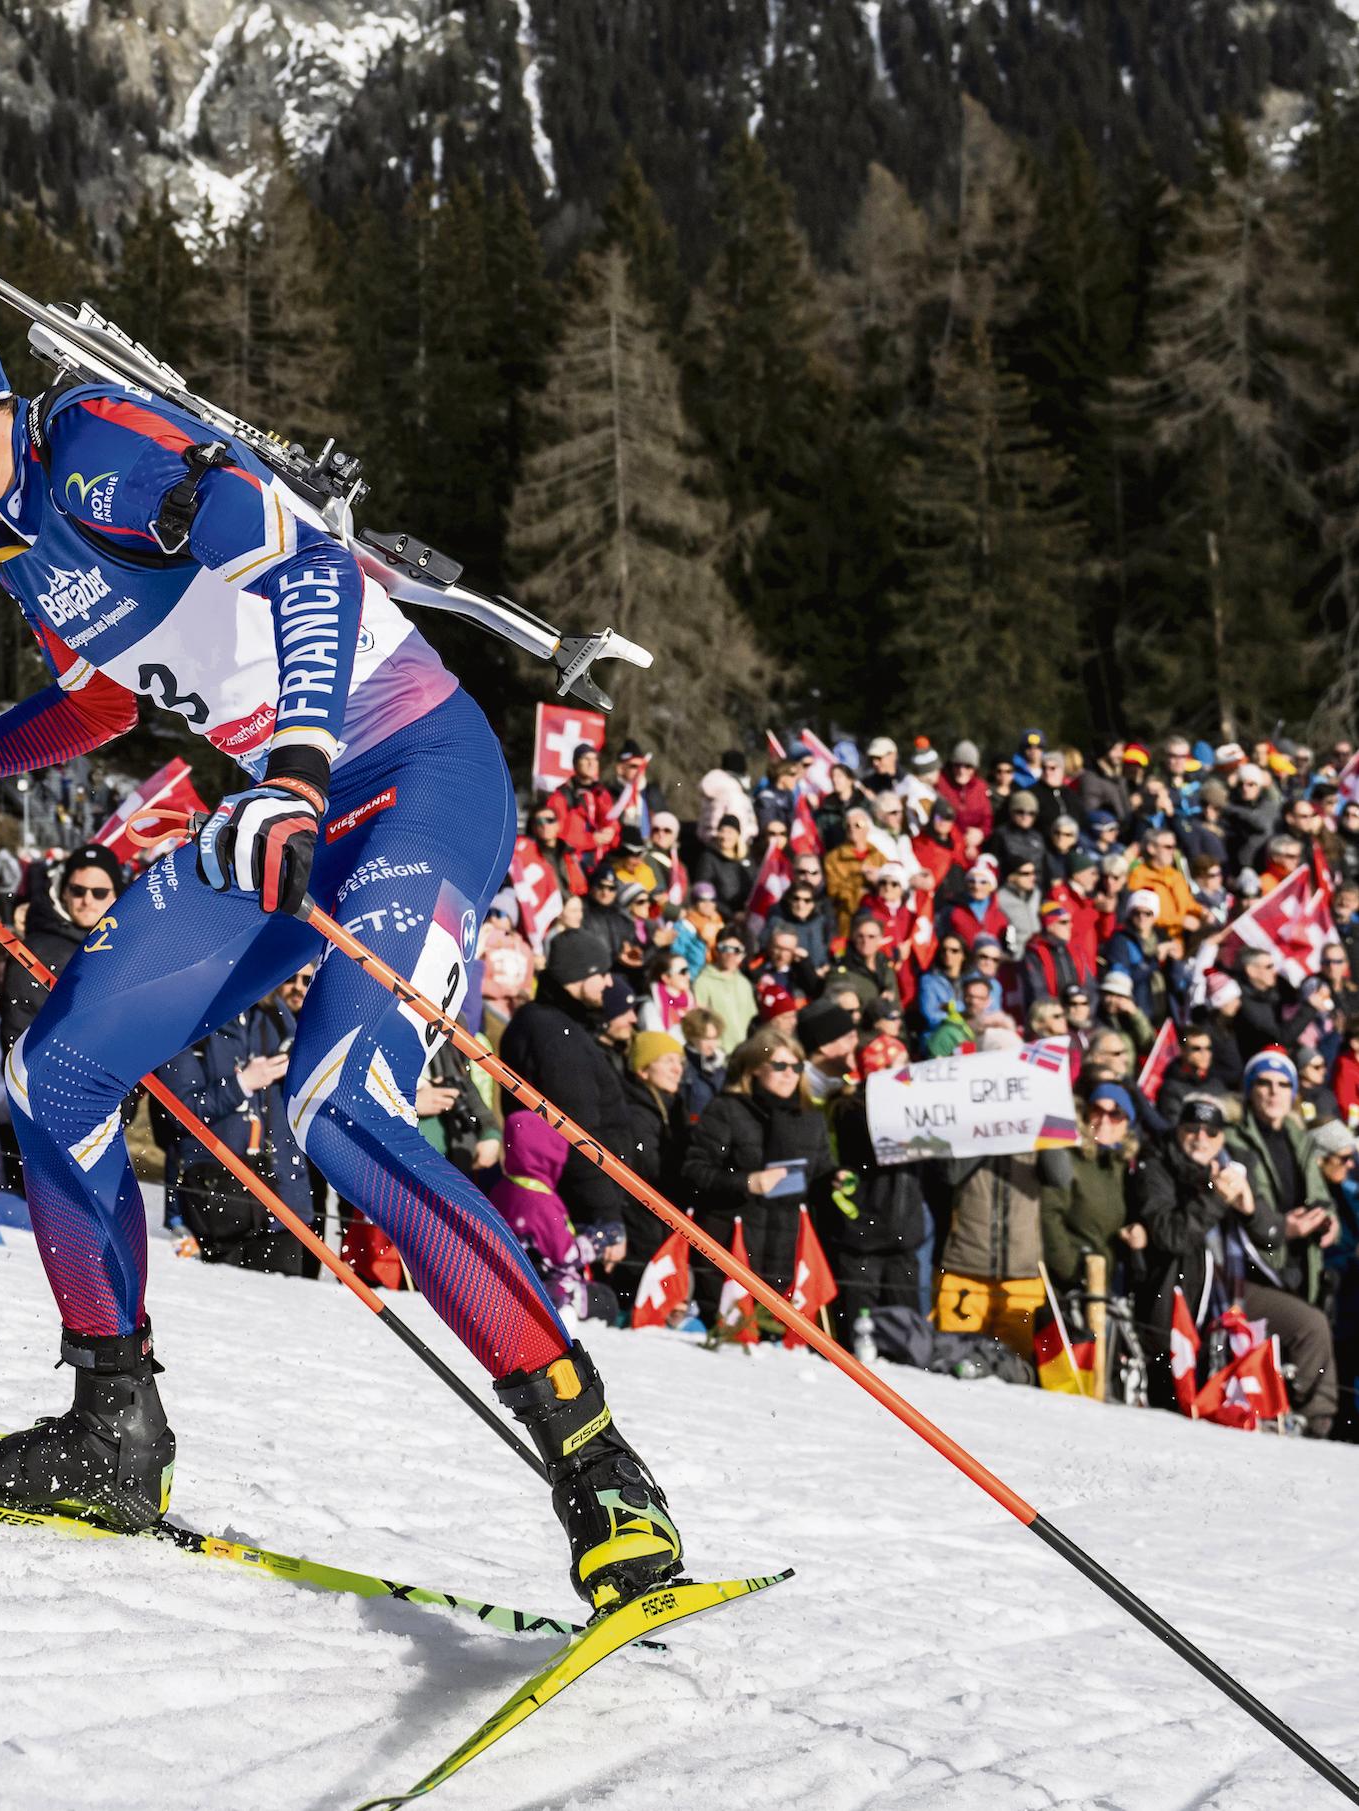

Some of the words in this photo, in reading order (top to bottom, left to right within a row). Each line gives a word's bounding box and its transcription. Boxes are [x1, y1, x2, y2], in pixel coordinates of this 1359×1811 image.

[91, 486, 104, 521] ROY
[103, 475, 119, 523] ENERGIE
[277, 567, 341, 722] FRANCE
[138, 663, 210, 724] 3
[337, 856, 390, 897] CAISSE
[641, 1592, 680, 1619] FISCHER
